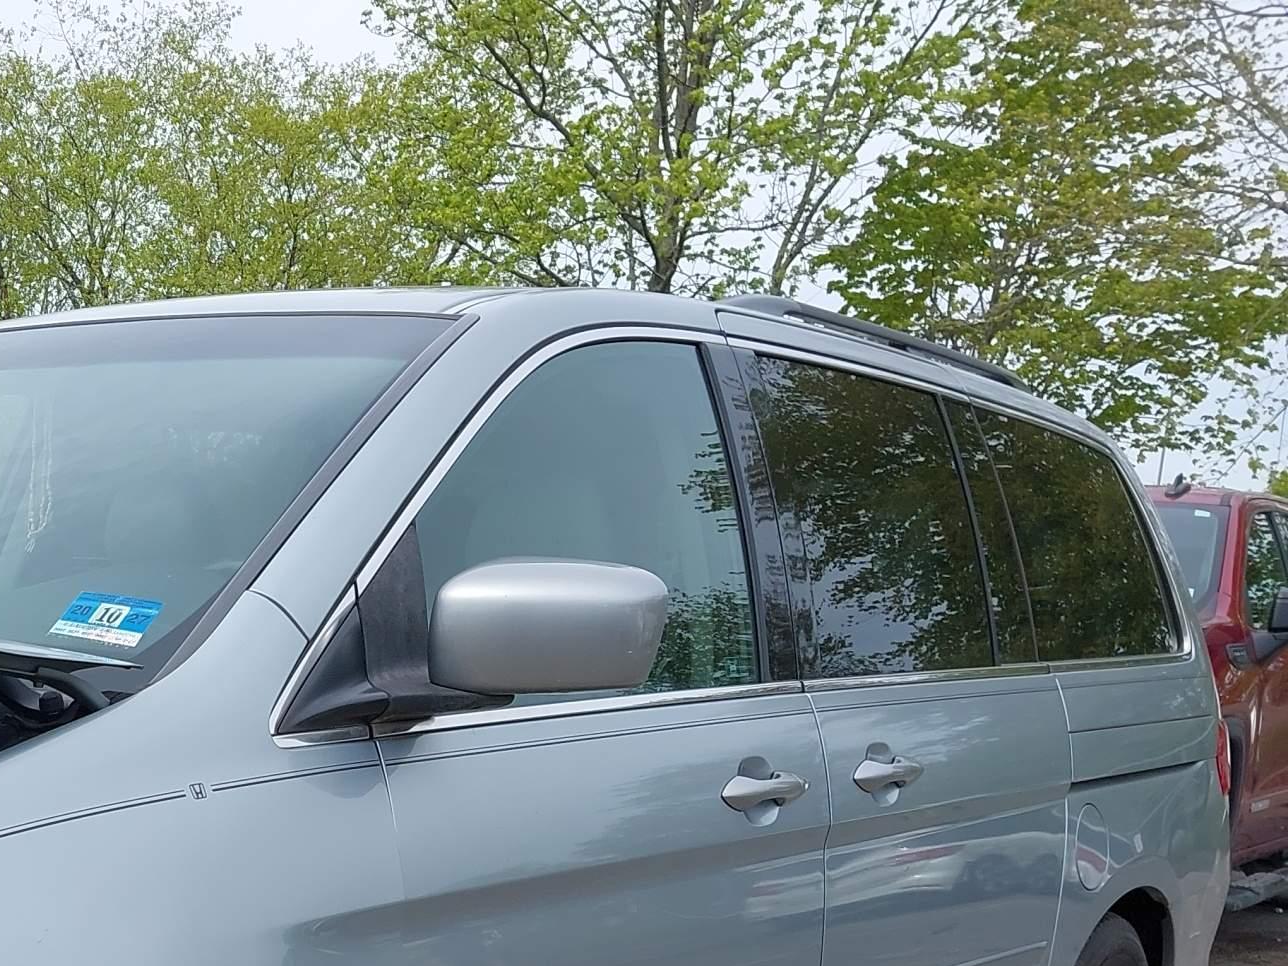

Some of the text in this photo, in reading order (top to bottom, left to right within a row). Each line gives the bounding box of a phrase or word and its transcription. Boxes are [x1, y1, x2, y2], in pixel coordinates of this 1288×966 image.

[71, 604, 151, 625] 20 10 27
